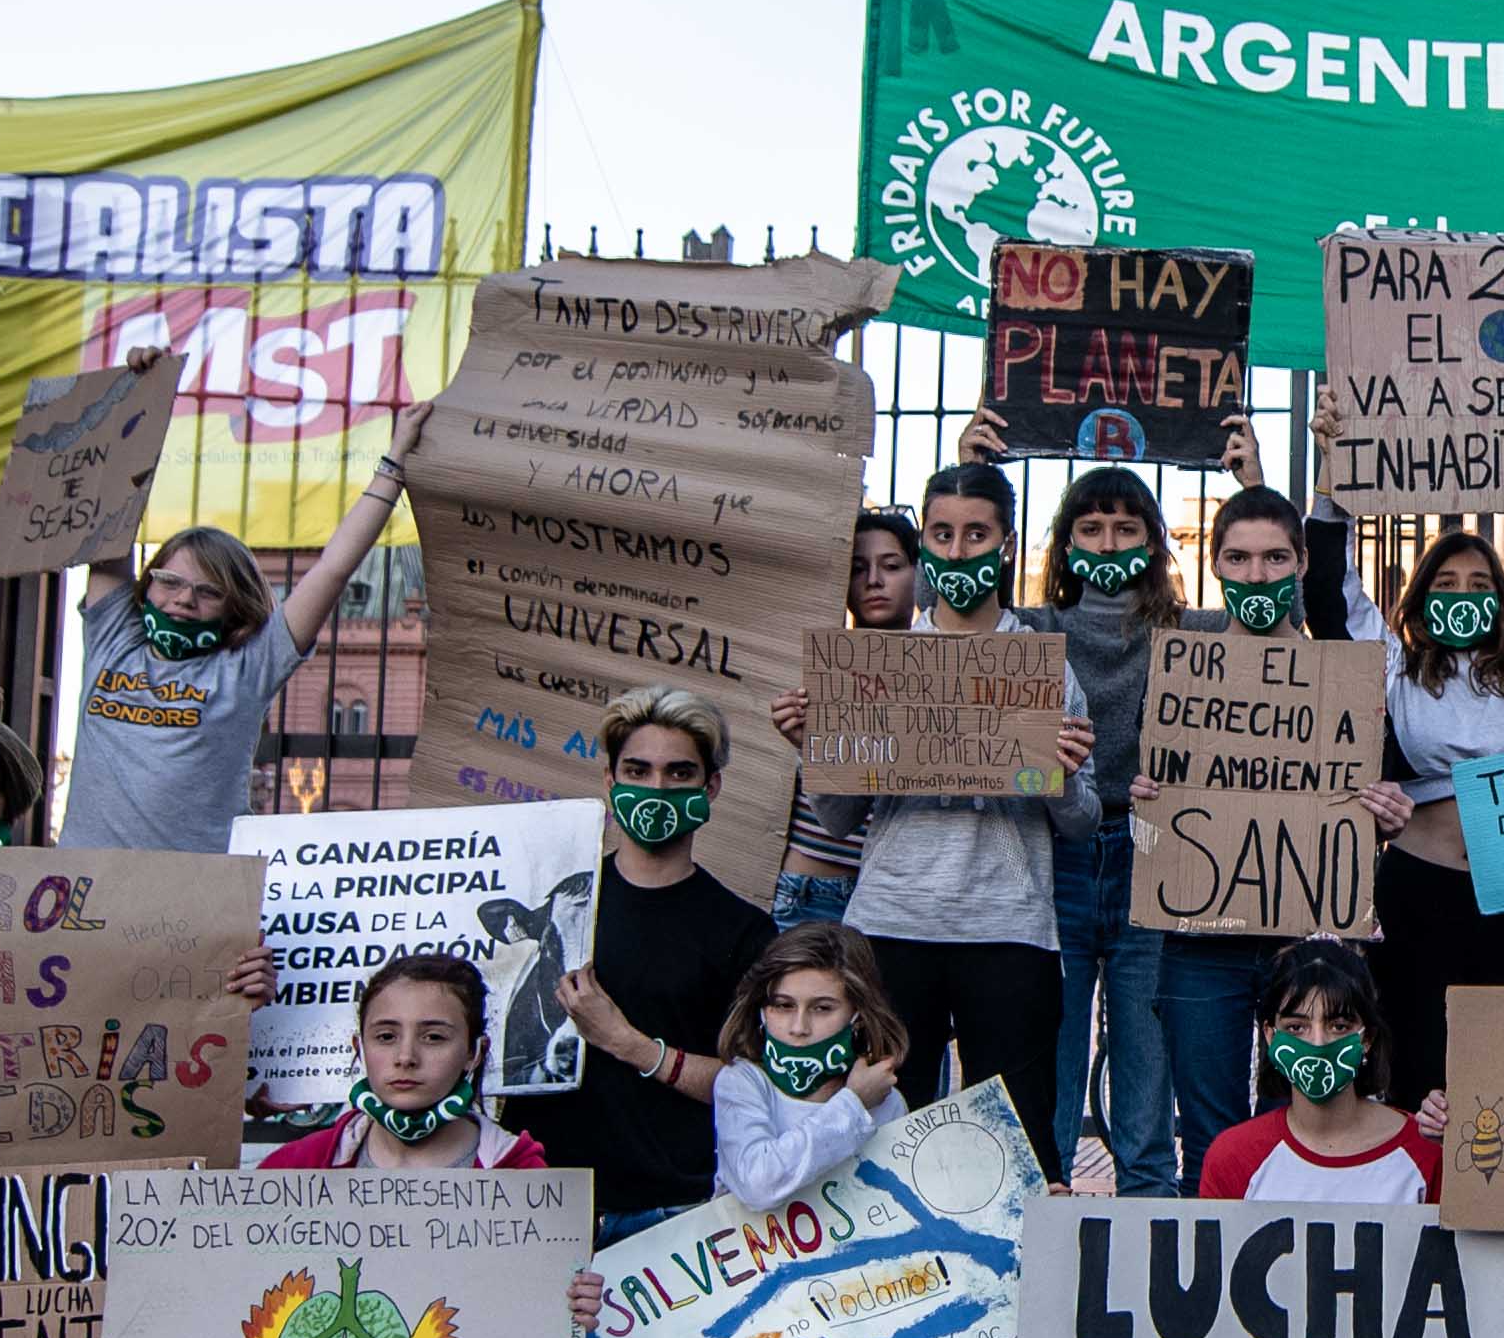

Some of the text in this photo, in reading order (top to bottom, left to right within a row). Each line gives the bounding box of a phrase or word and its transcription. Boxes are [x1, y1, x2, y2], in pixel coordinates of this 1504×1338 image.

[951, 88, 1032, 127] FOR
[999, 251, 1230, 318] NO HAY
[1339, 246, 1451, 302] PARA
[529, 277, 639, 334] TANTO
[1407, 314, 1462, 363] EL
[995, 320, 1242, 407] PLANETA
[1347, 375, 1407, 417] VA
[1427, 377, 1453, 416] A
[47, 444, 109, 479] CLEAN
[564, 462, 680, 503] AHORA
[810, 633, 1058, 678] NO QUE
[1164, 637, 1311, 688] POR EL
[895, 672, 936, 705] POR
[88, 695, 200, 728] CONDORS
[904, 708, 967, 735] DONDE
[1157, 692, 1356, 745] DERECHO A
[1148, 746, 1192, 784] UN
[296, 830, 502, 866] GANADERÍA
[291, 869, 507, 901] LA PRINCIPAL
[1157, 807, 1361, 930] SANO
[371, 911, 448, 932] DE LA
[125, 1172, 565, 1209] LA AMAZONÍA REPRESENTA UN
[114, 1212, 412, 1250] 20% DEL OXÍGENO DEL
[602, 1180, 856, 1338] SALVEMOS
[26, 1278, 95, 1316] LUCHA
